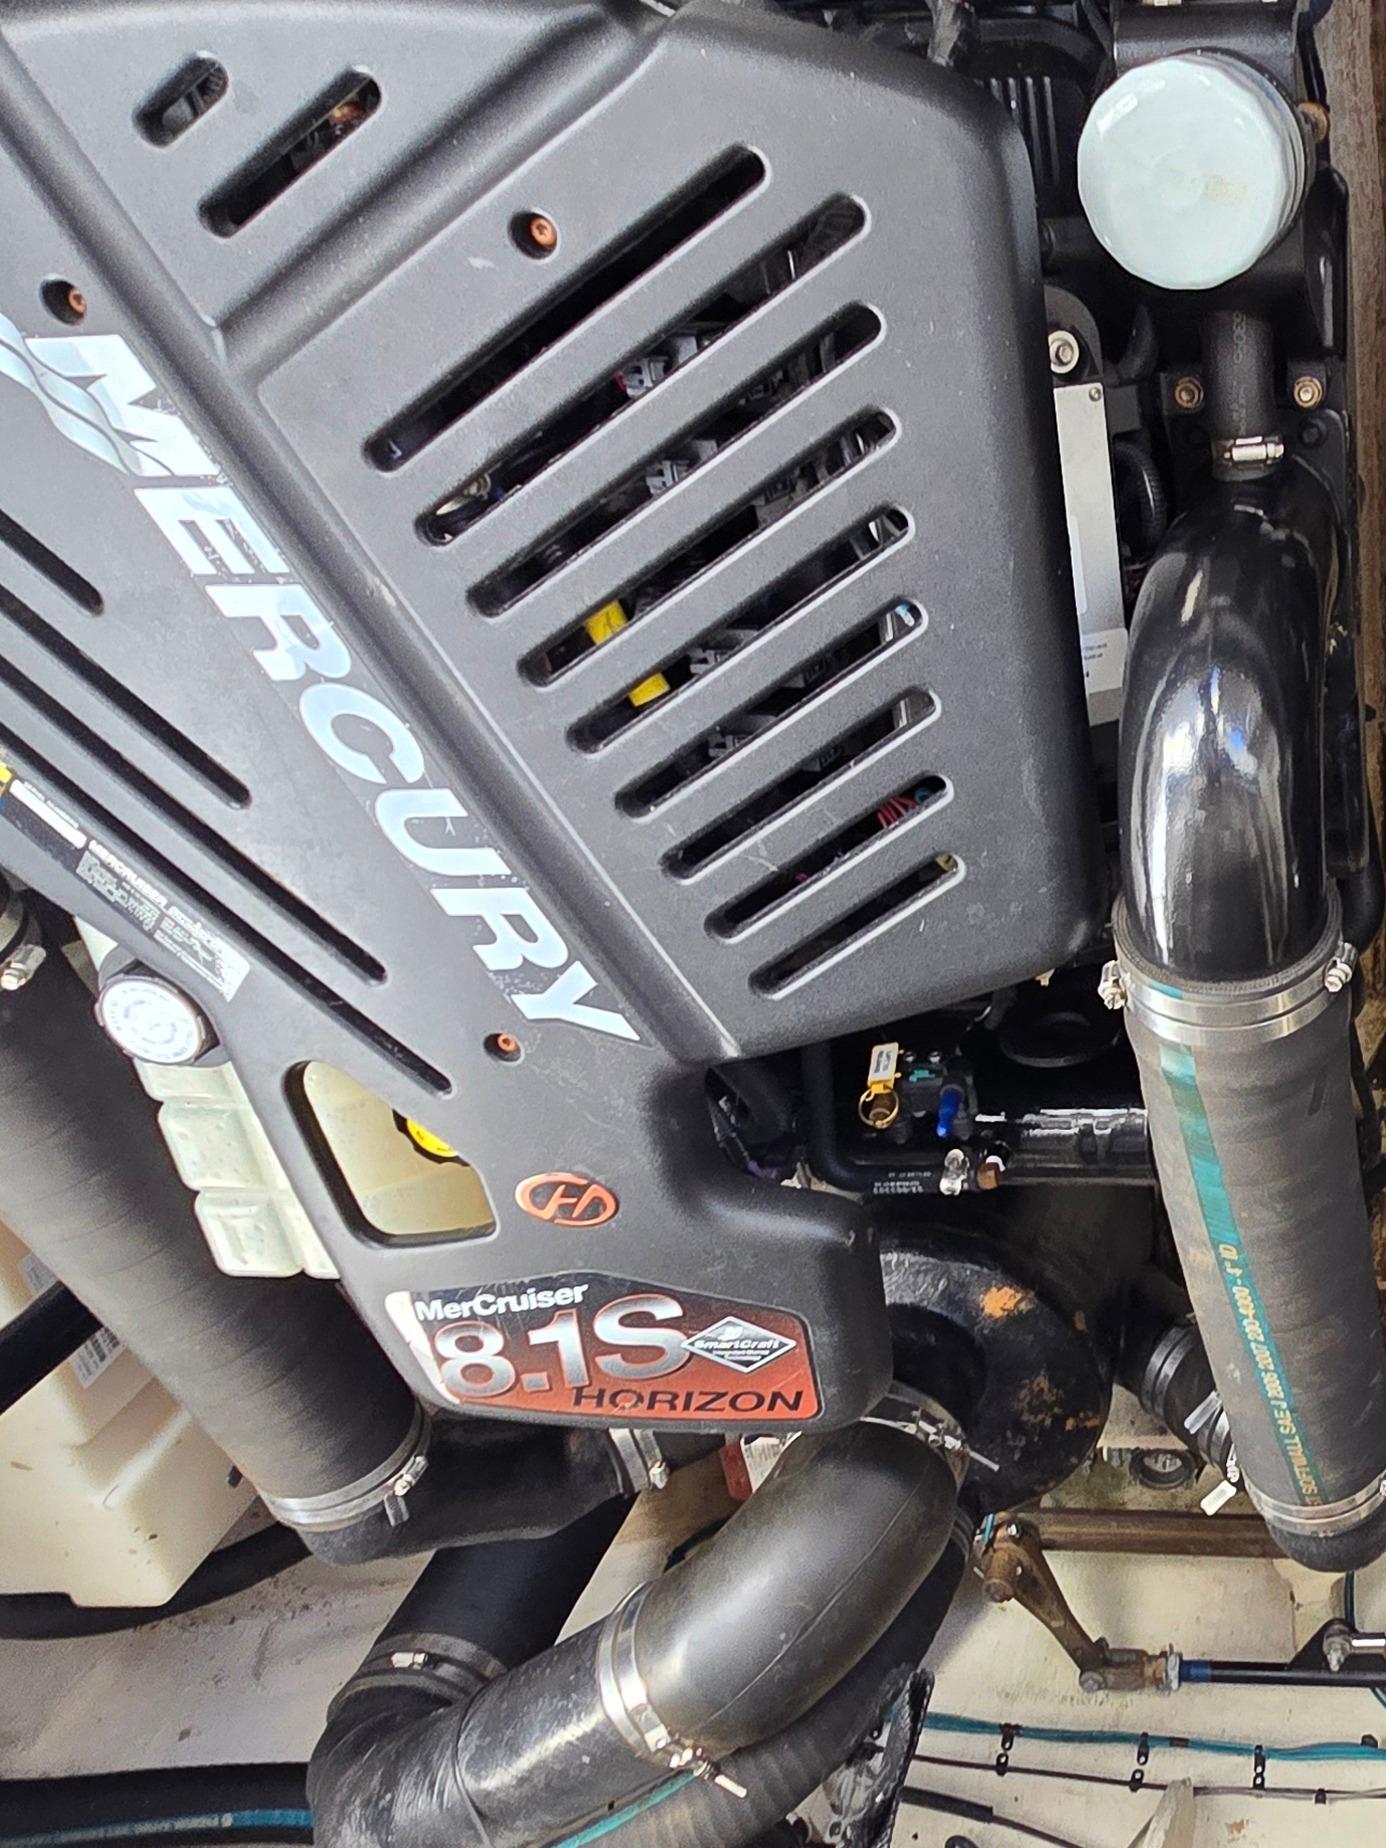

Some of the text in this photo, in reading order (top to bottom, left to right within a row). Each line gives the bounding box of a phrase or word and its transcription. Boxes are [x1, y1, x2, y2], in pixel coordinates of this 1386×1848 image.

[22, 334, 641, 1043] MERCURY
[414, 1283, 589, 1323] MerCruiser
[433, 1293, 692, 1399] 8.1S
[694, 1338, 780, 1350] SmartCraft
[572, 1386, 804, 1412] HORIZON
